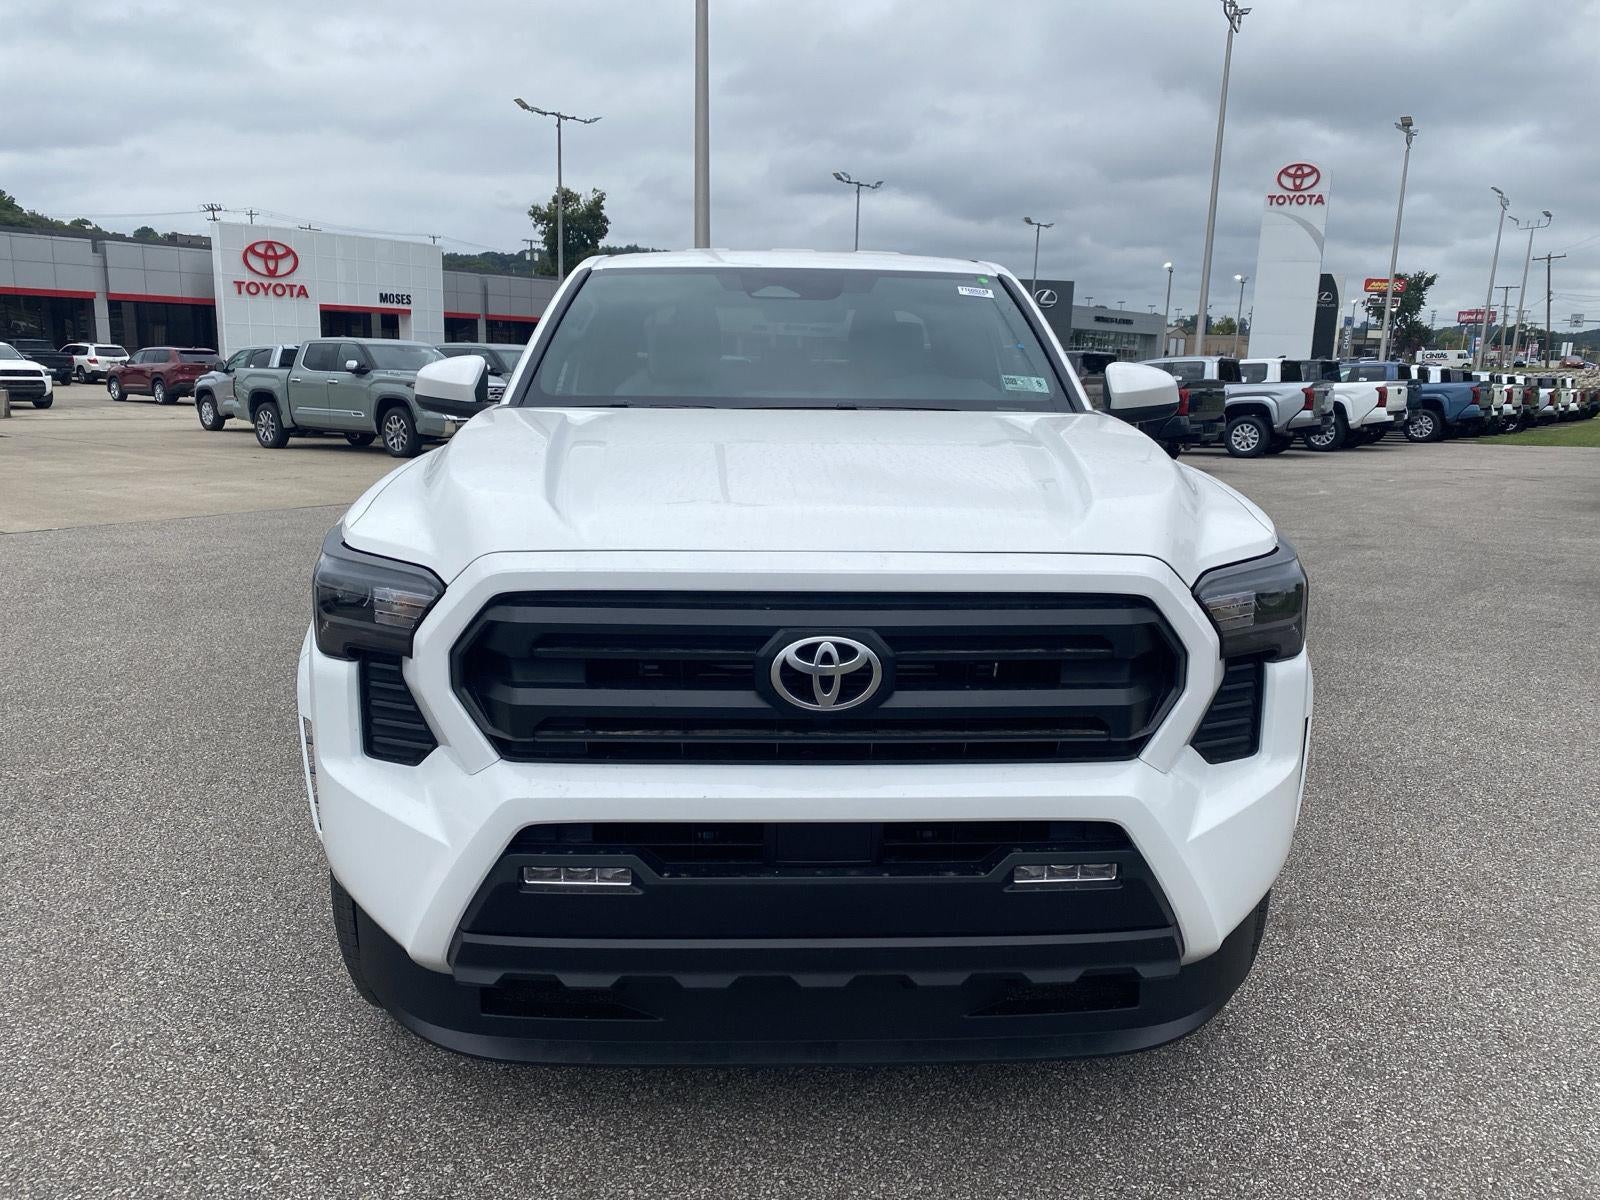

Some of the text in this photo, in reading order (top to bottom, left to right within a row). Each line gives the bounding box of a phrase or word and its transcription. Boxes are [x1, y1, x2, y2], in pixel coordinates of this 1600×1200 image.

[1267, 194, 1325, 206] TOYOTA
[233, 280, 309, 299] TOYOTA
[379, 292, 412, 305] MOSES
[1343, 325, 1352, 349] CHASE
